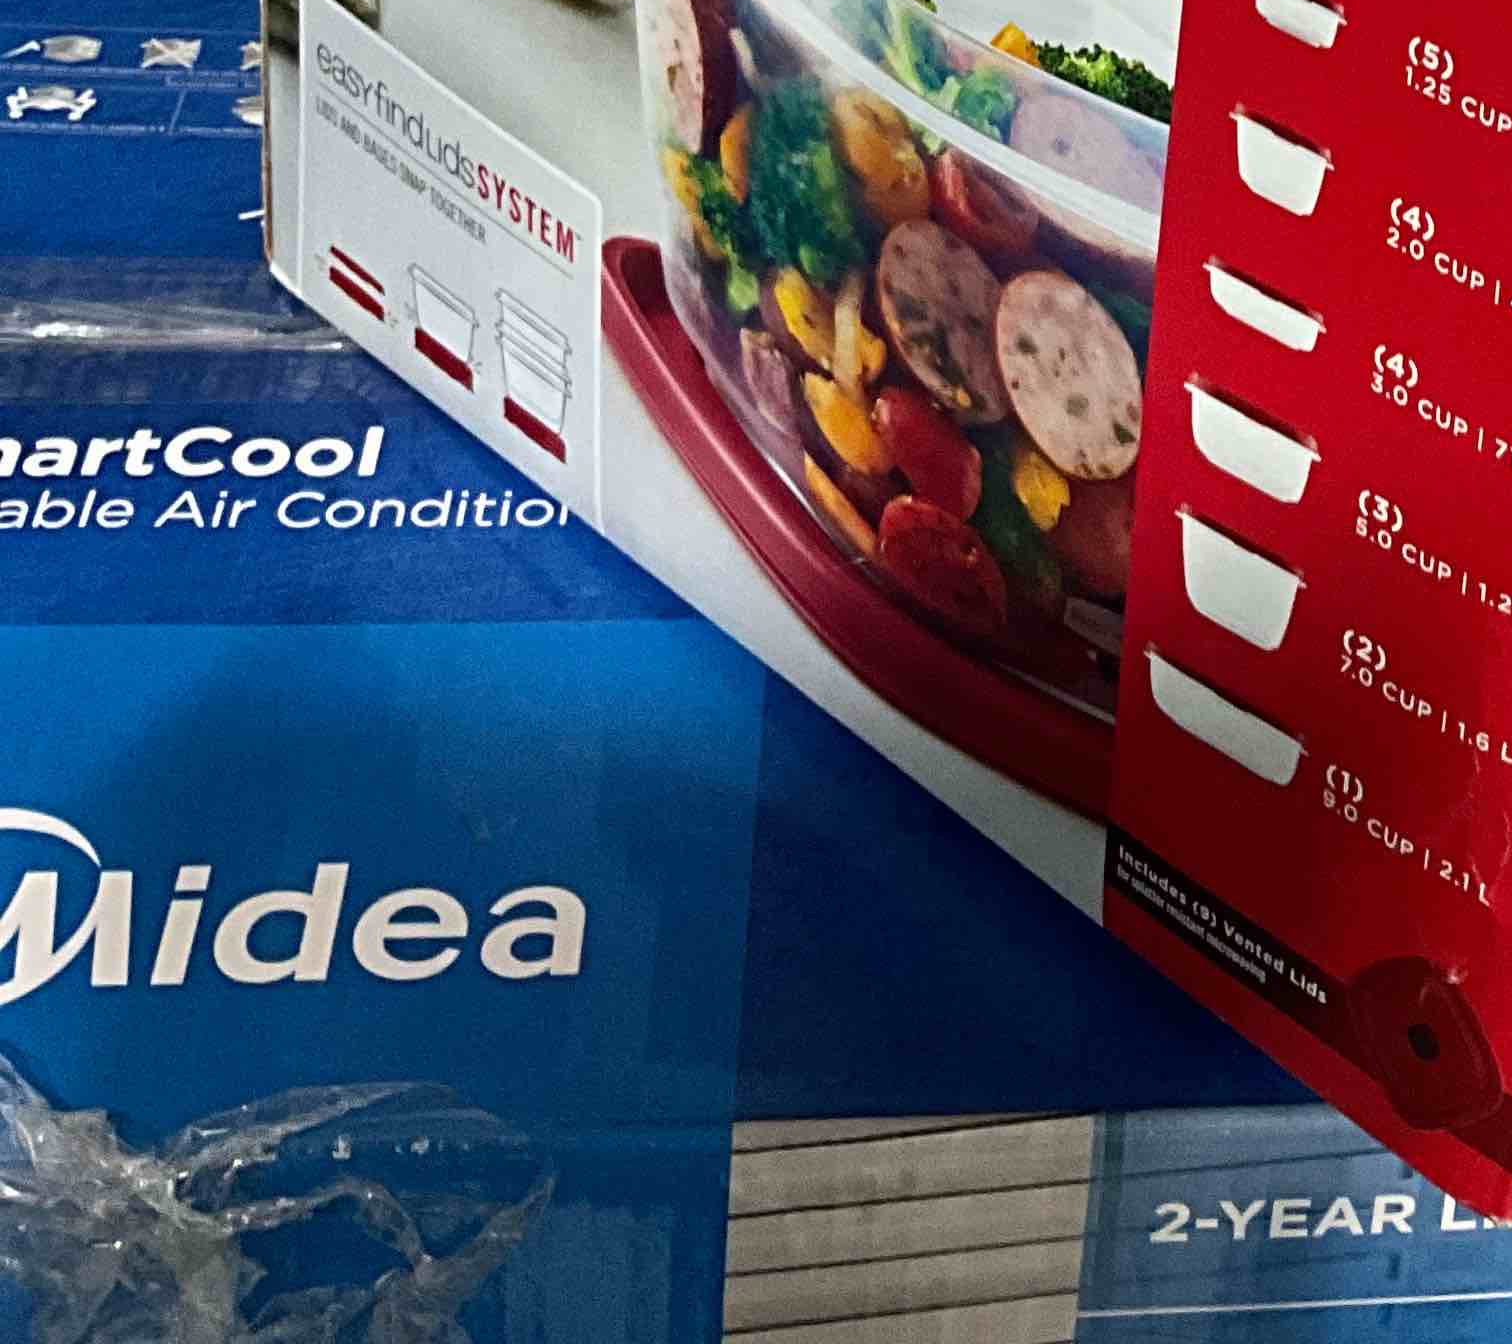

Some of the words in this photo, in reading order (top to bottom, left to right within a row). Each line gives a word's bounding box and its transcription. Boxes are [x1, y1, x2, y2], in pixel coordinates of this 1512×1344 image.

[1407, 36, 1456, 81] (5)
[1403, 66, 1452, 107] 1.25
[1389, 198, 1436, 242] (4)
[1385, 227, 1426, 262] 2.0
[1433, 252, 1486, 292] CUP
[1372, 344, 1420, 389] (4)
[1369, 375, 1410, 408] 3.0
[1416, 397, 1470, 438] CUP
[153, 489, 257, 529] Air
[1357, 488, 1404, 533] (3)
[1354, 516, 1393, 552] 5.0
[1400, 542, 1453, 583] CUP
[1477, 581, 1512, 616] 1.2
[1341, 629, 1387, 672] (2)
[1339, 655, 1374, 689] 7.0
[1380, 680, 1433, 720] CUP
[1456, 720, 1490, 754] 1.6
[1324, 763, 1365, 805] (1)
[1365, 817, 1415, 858] CUP
[1439, 859, 1473, 893] 2.1
[1474, 880, 1492, 908] L
[0, 862, 587, 988] Midea
[1117, 844, 1188, 907] Includes
[1222, 918, 1286, 978] Vented
[1288, 967, 1330, 1006] Lids
[1149, 1196, 1415, 1246] 2-YEAR
